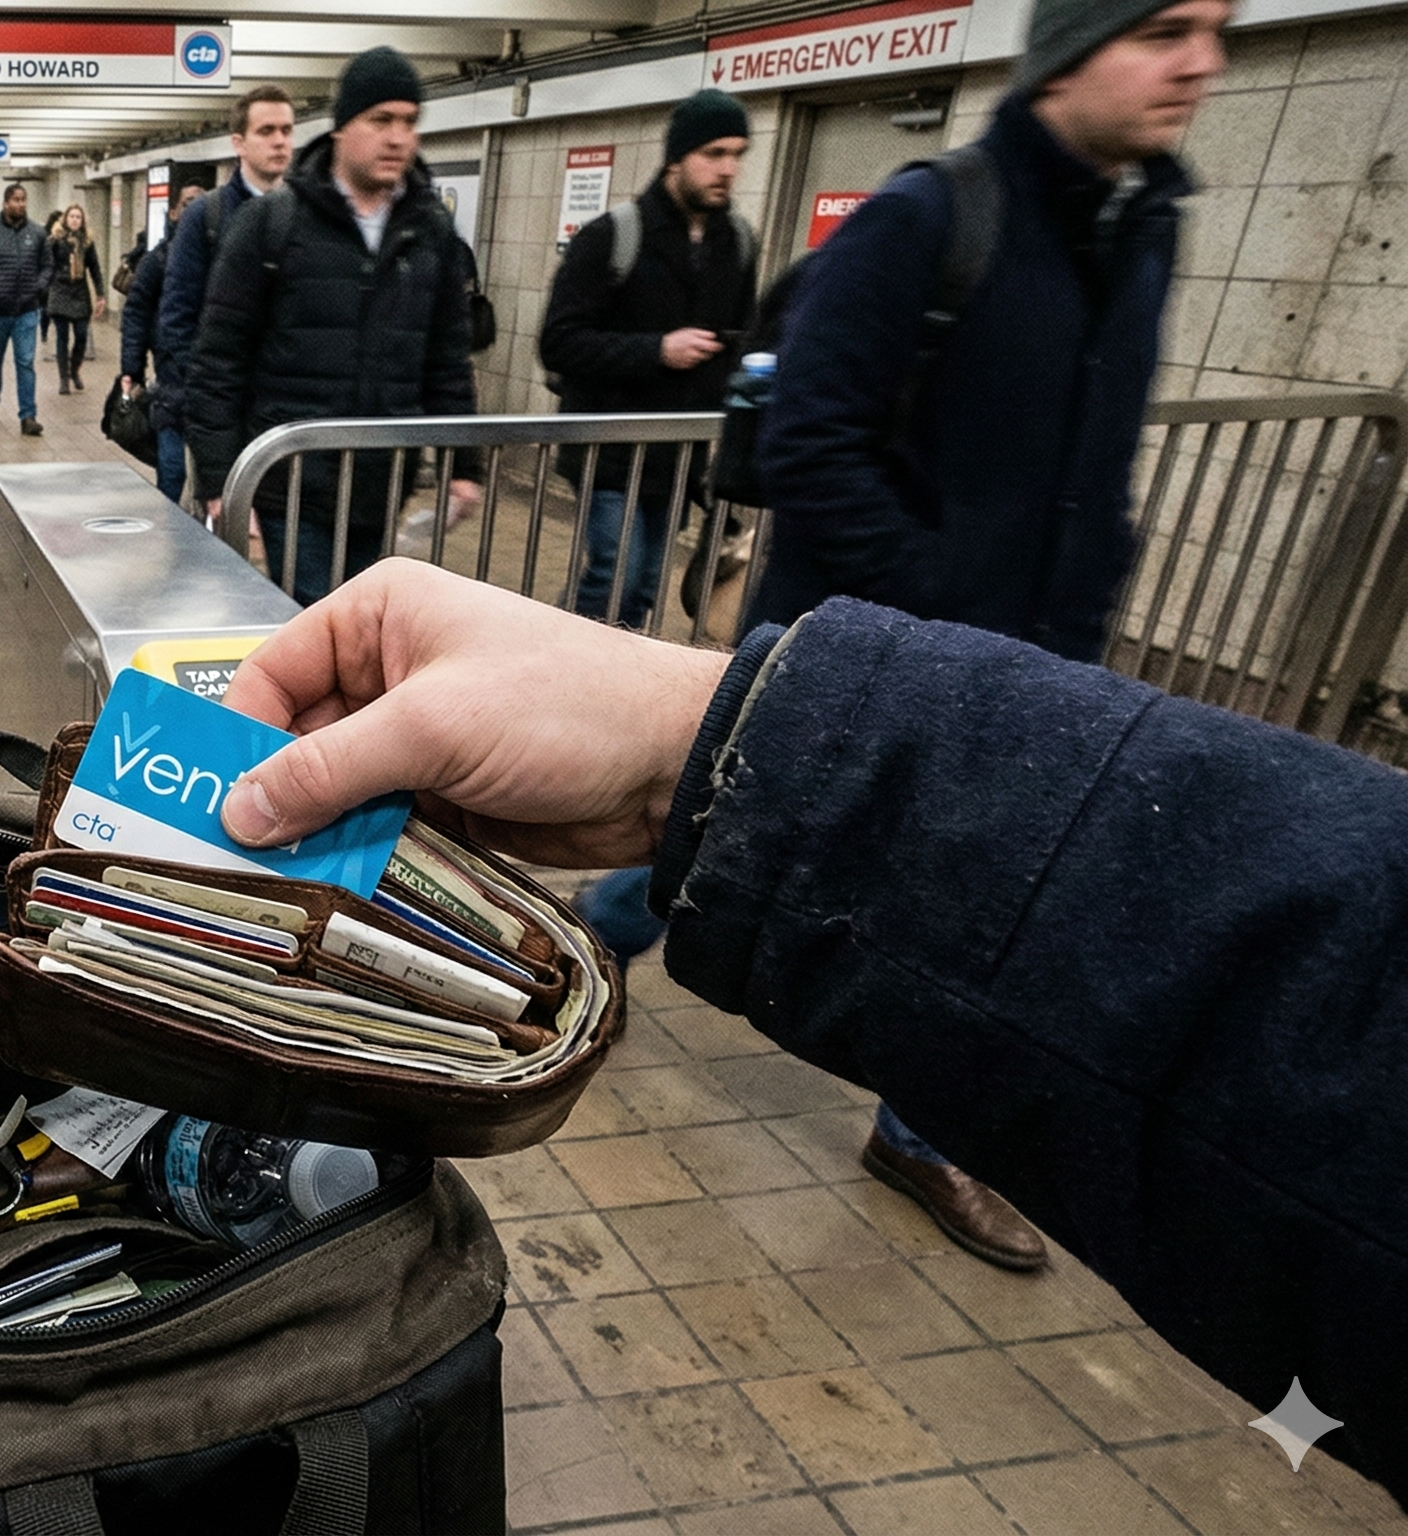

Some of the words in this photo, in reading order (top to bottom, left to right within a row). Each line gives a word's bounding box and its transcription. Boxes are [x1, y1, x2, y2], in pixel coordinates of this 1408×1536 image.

[187, 46, 218, 63] cta
[730, 32, 884, 82] EMERGENCY
[888, 20, 957, 60] EXIT
[8, 60, 100, 77] HOWARD
[816, 198, 867, 216] EMER
[185, 670, 221, 683] TAP
[194, 683, 230, 697] CAR
[72, 812, 117, 843] cta
